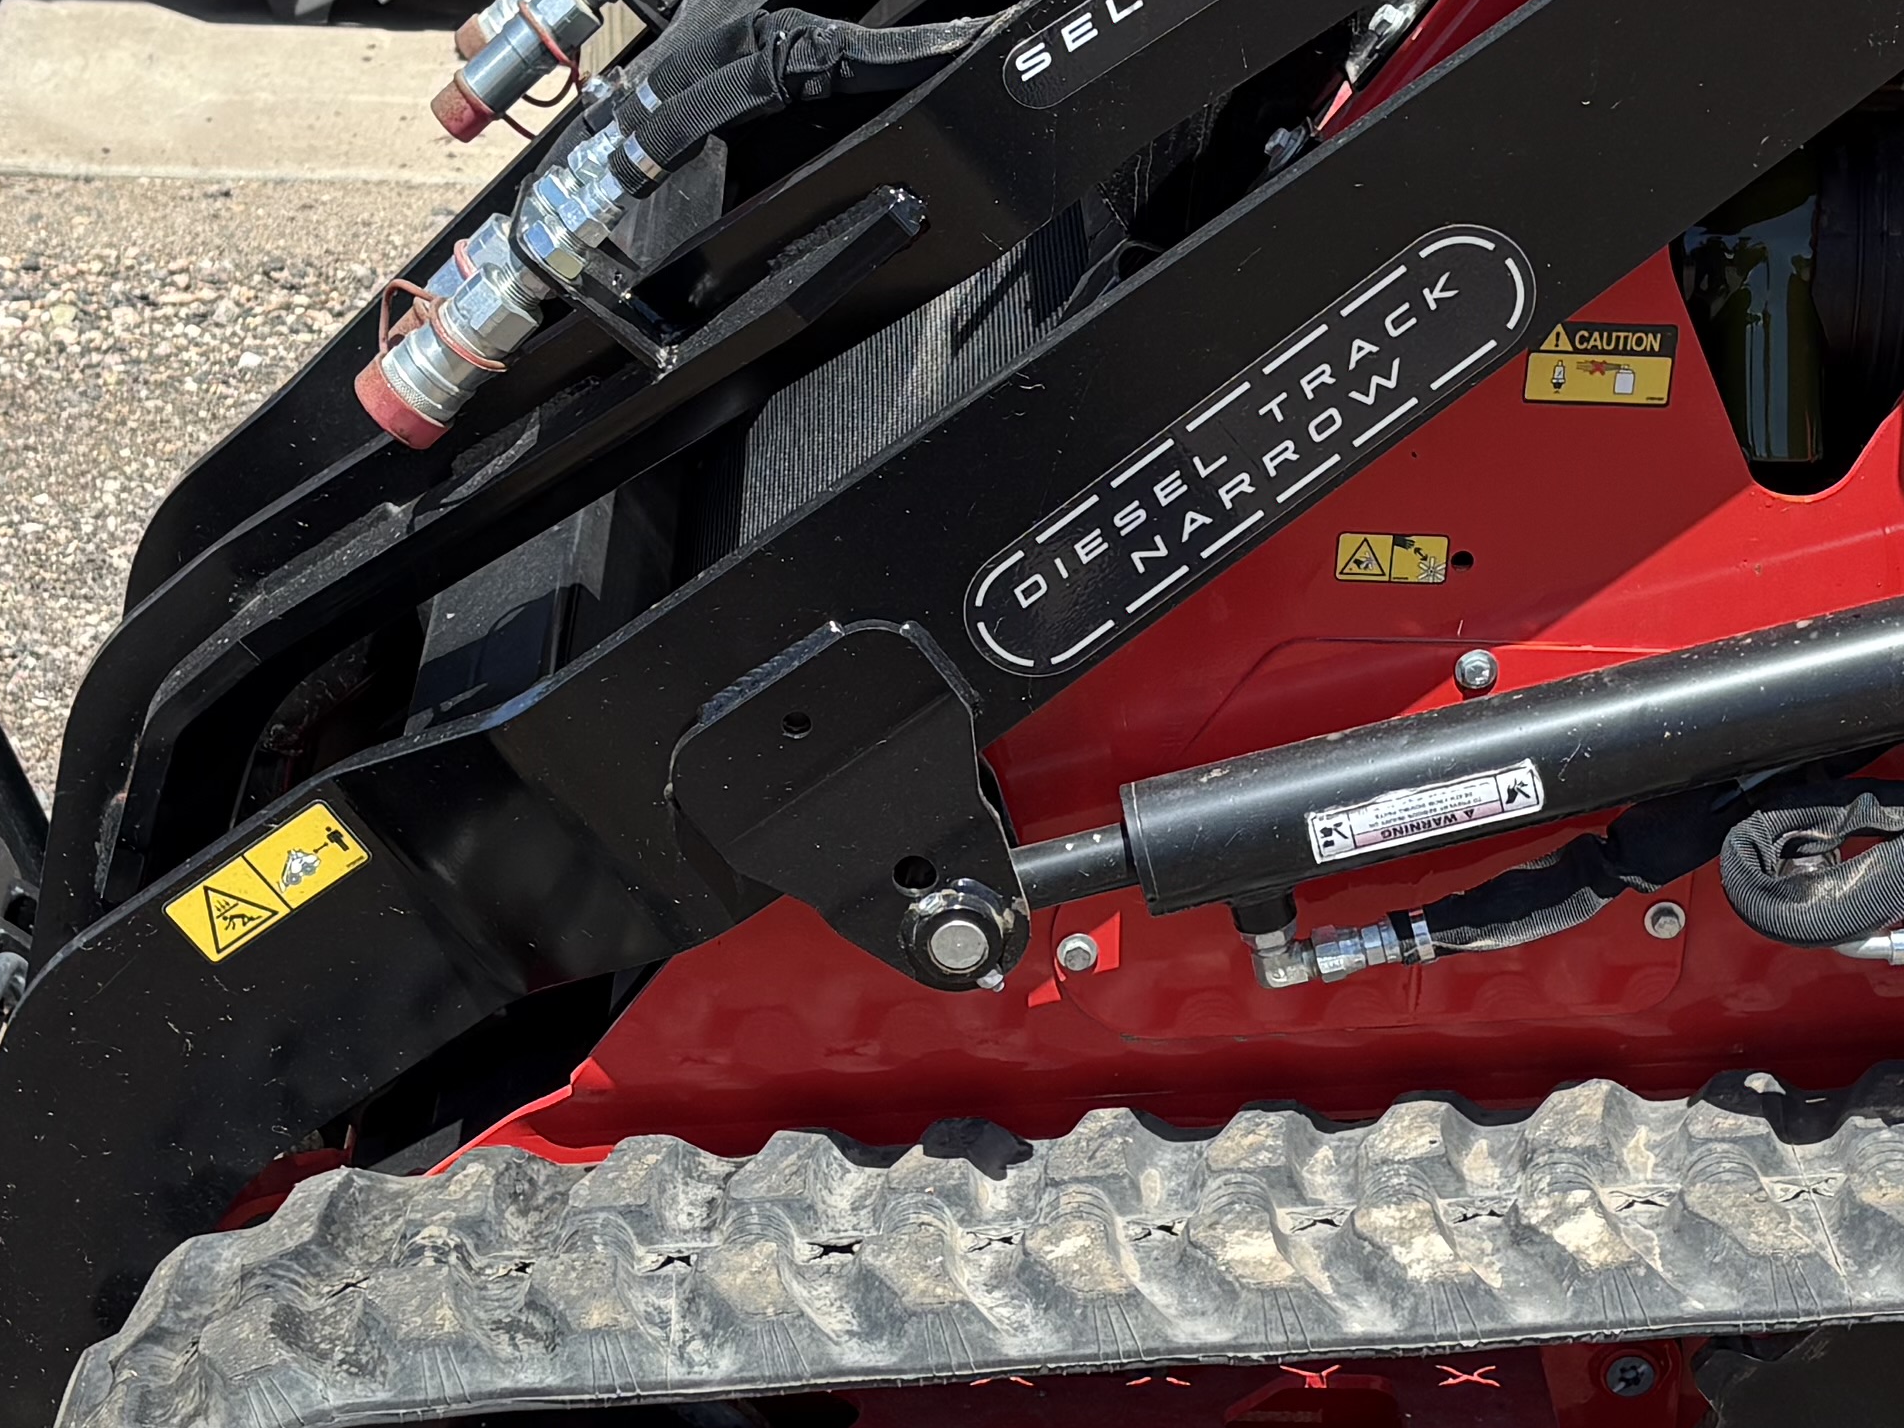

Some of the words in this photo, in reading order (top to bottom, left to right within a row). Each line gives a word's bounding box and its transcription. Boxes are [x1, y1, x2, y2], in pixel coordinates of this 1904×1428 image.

[1574, 330, 1662, 352] CAUTION
[1014, 448, 1230, 611] DIESEL
[1258, 271, 1461, 422] TRACK
[1129, 356, 1405, 574] NARROW
[1379, 812, 1457, 839] WARNING
